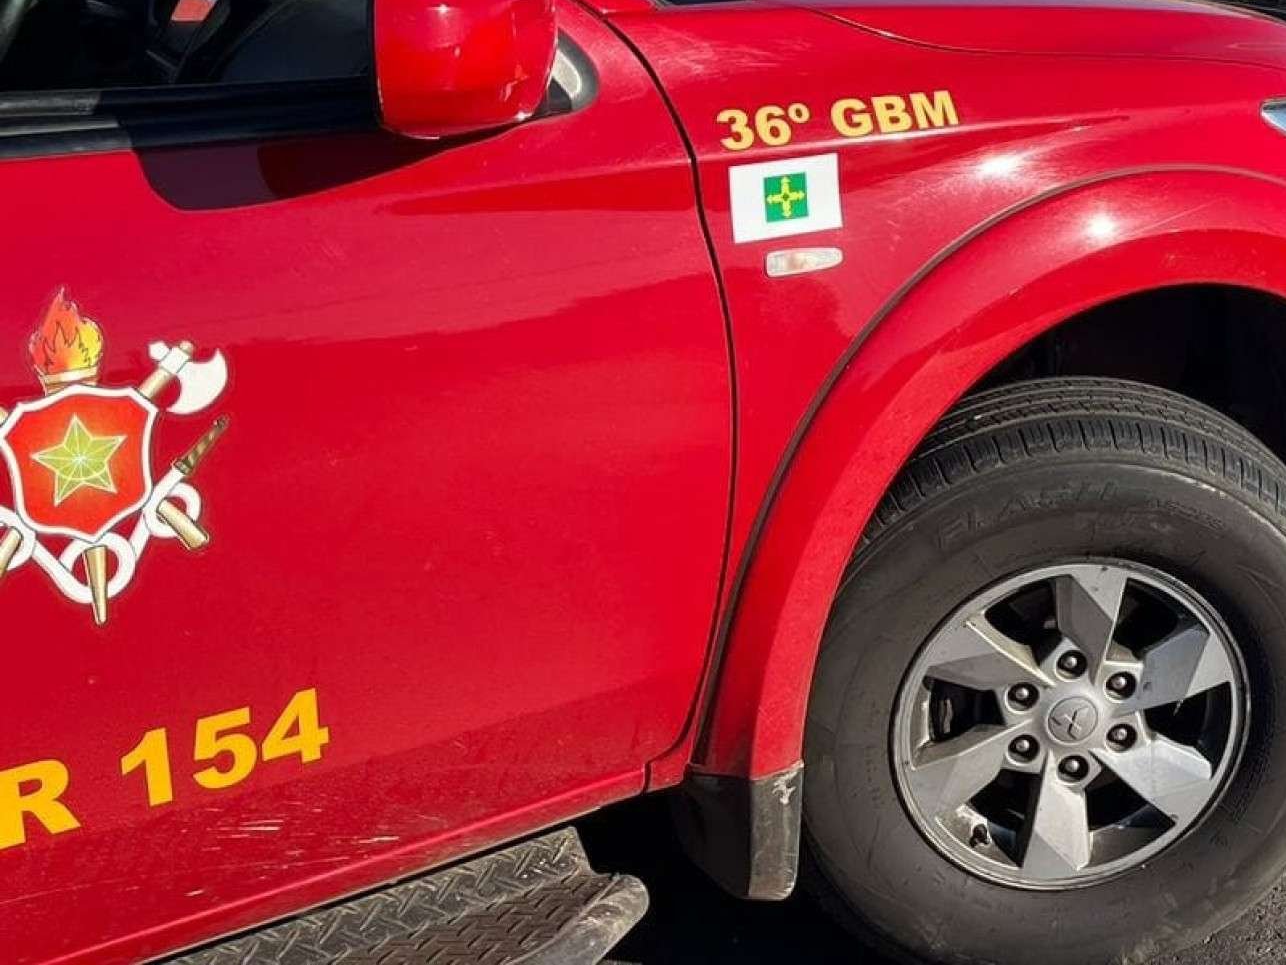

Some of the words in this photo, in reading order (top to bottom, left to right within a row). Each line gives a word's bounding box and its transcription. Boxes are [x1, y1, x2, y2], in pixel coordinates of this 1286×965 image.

[830, 90, 959, 138] GBM
[0, 758, 82, 850] R
[121, 687, 330, 807] 154
